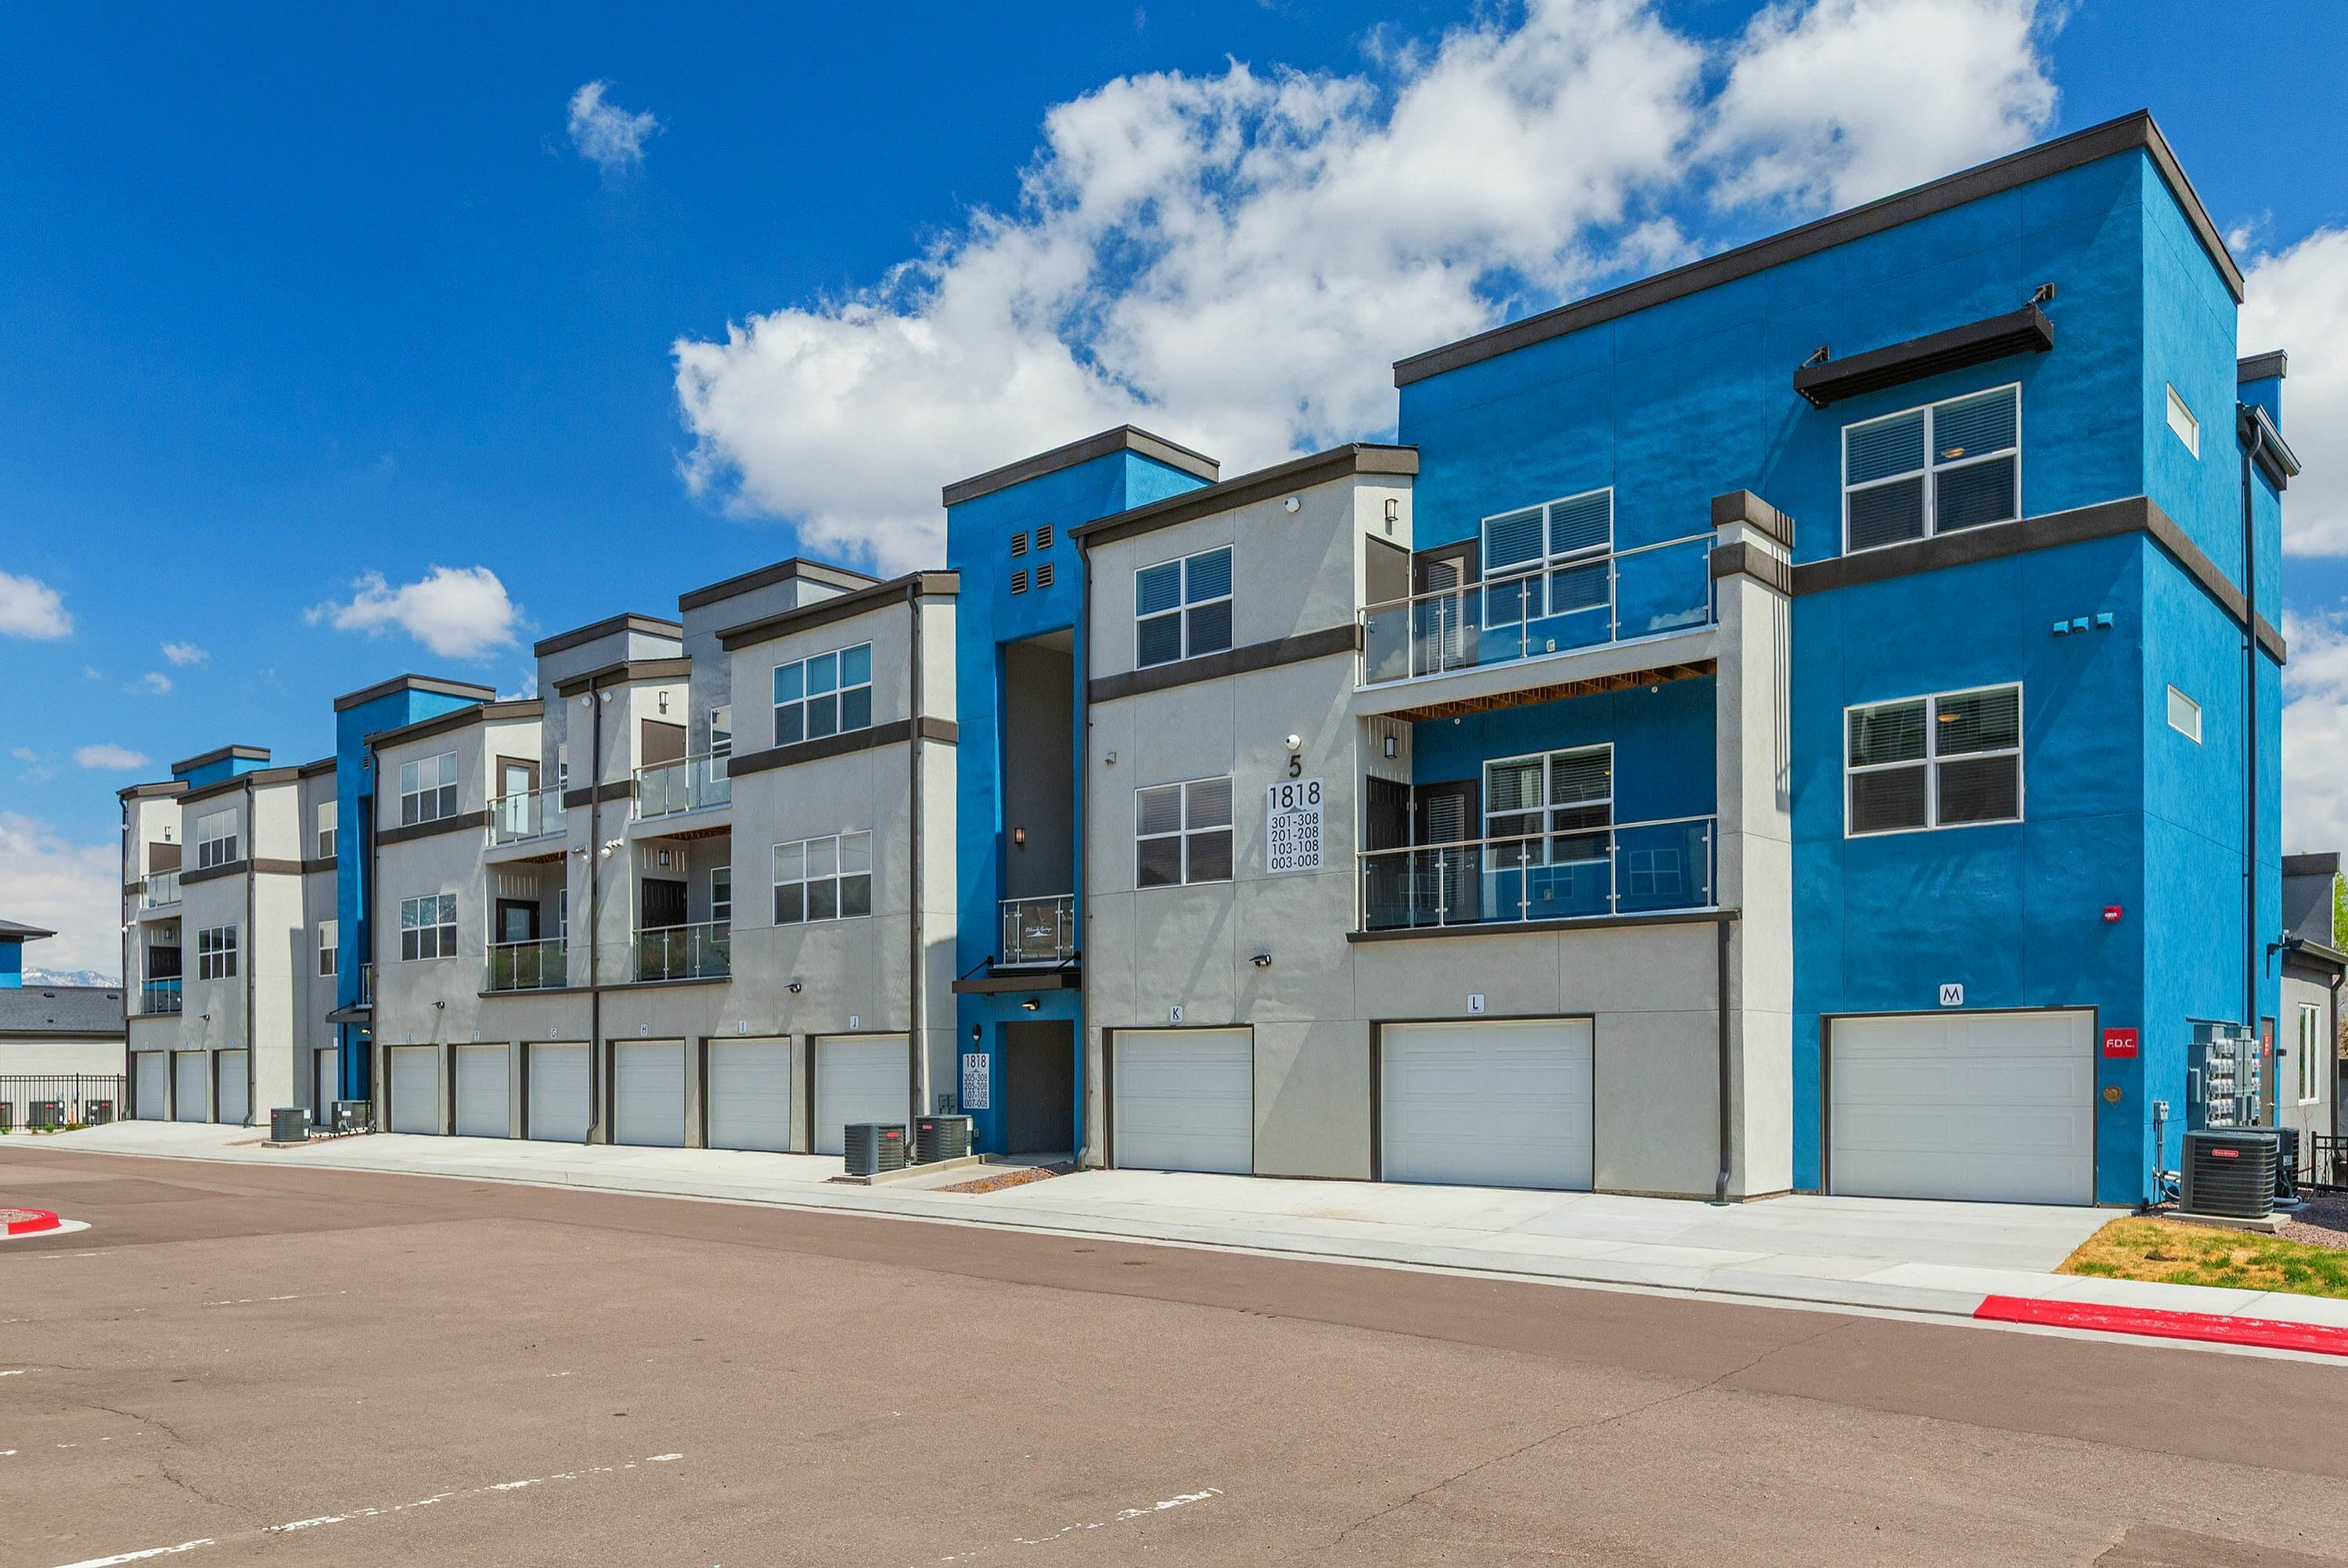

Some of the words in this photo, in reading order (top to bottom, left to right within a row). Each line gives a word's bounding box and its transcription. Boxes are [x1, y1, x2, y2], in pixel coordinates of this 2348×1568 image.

[1289, 754, 1302, 777] 5
[1269, 782, 1320, 809] 1818
[1272, 812, 1319, 829] 301-308
[1272, 825, 1319, 842] 201-208
[1273, 840, 1319, 855] 103-108
[1271, 854, 1319, 869] 003-008
[1943, 987, 1960, 1002] M
[1472, 996, 1479, 1009] L
[1172, 1008, 1179, 1019] K
[551, 1029, 556, 1038] G
[642, 1025, 646, 1034] H
[2106, 1038, 2135, 1048] F.D.C.
[966, 1055, 986, 1068] 1818
[964, 1082, 988, 1090] 205-208
[964, 1091, 988, 1099] 107-108
[964, 1099, 988, 1108] 007-008
